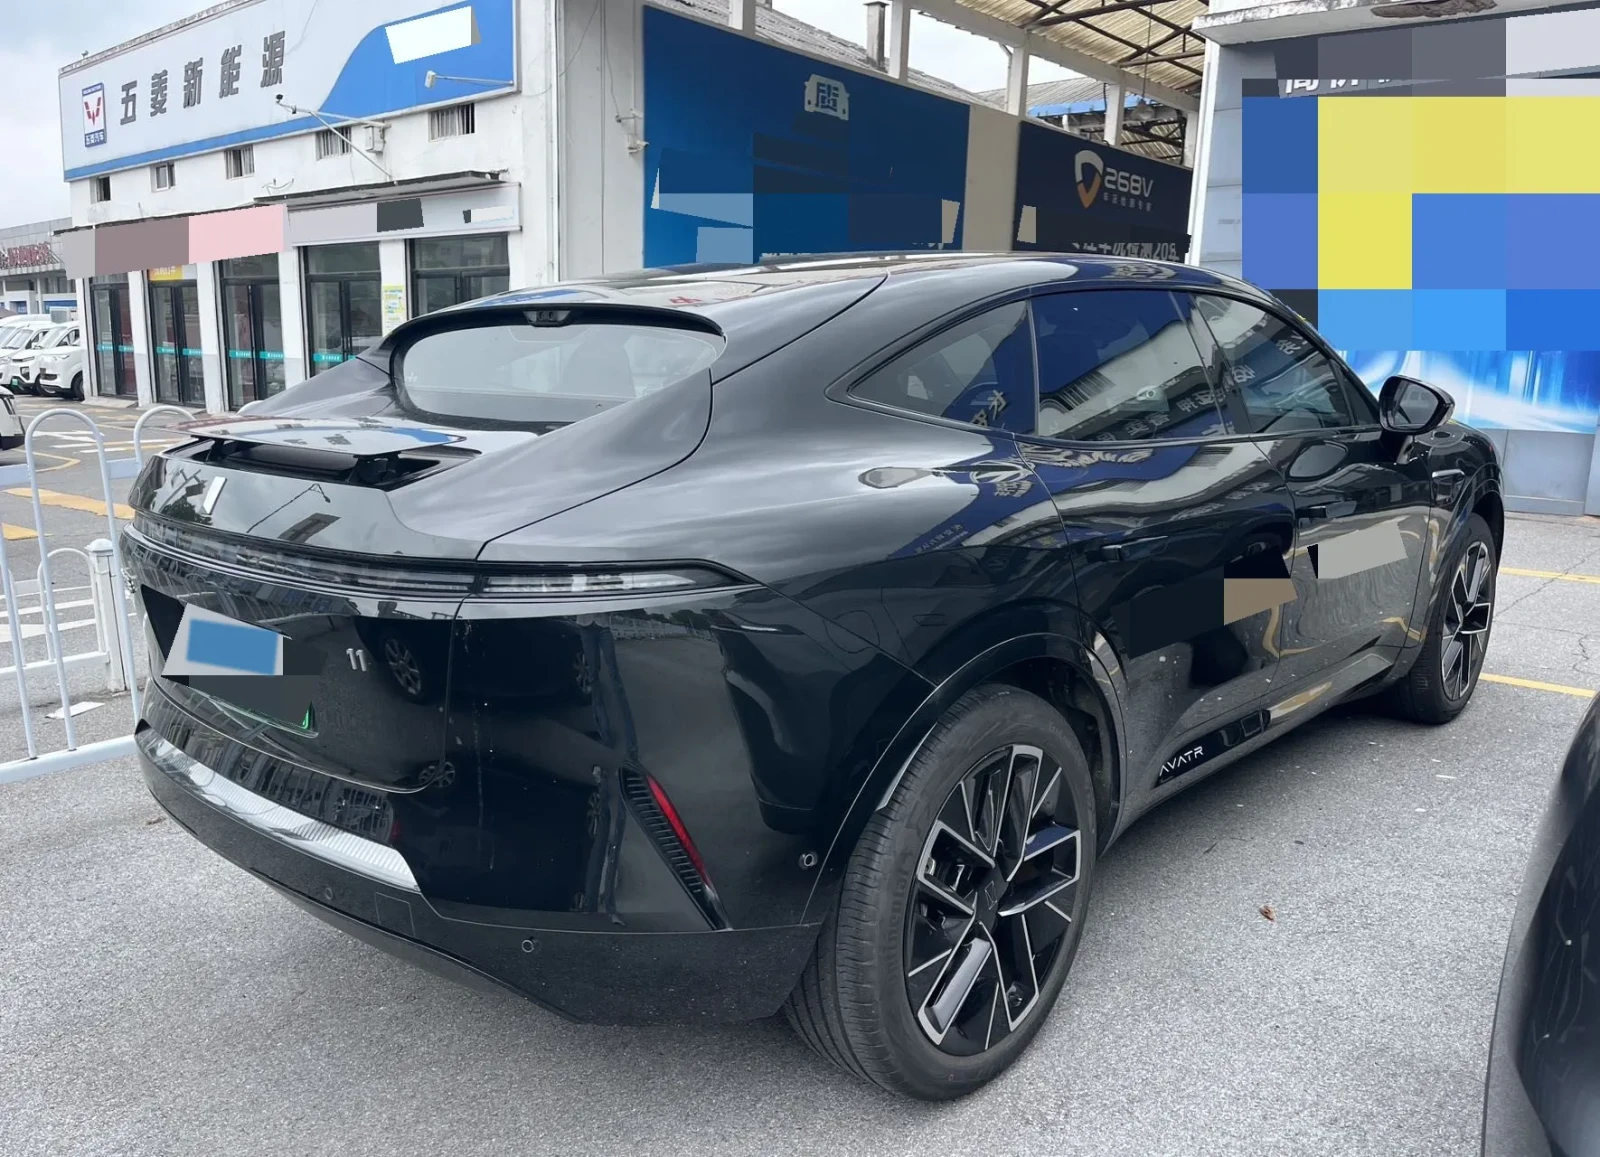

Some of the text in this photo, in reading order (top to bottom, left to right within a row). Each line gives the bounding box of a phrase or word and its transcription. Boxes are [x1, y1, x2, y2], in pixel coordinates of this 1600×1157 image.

[120, 30, 286, 126] 五菱新能源
[1104, 167, 1154, 198] 268V
[346, 648, 367, 671] 11
